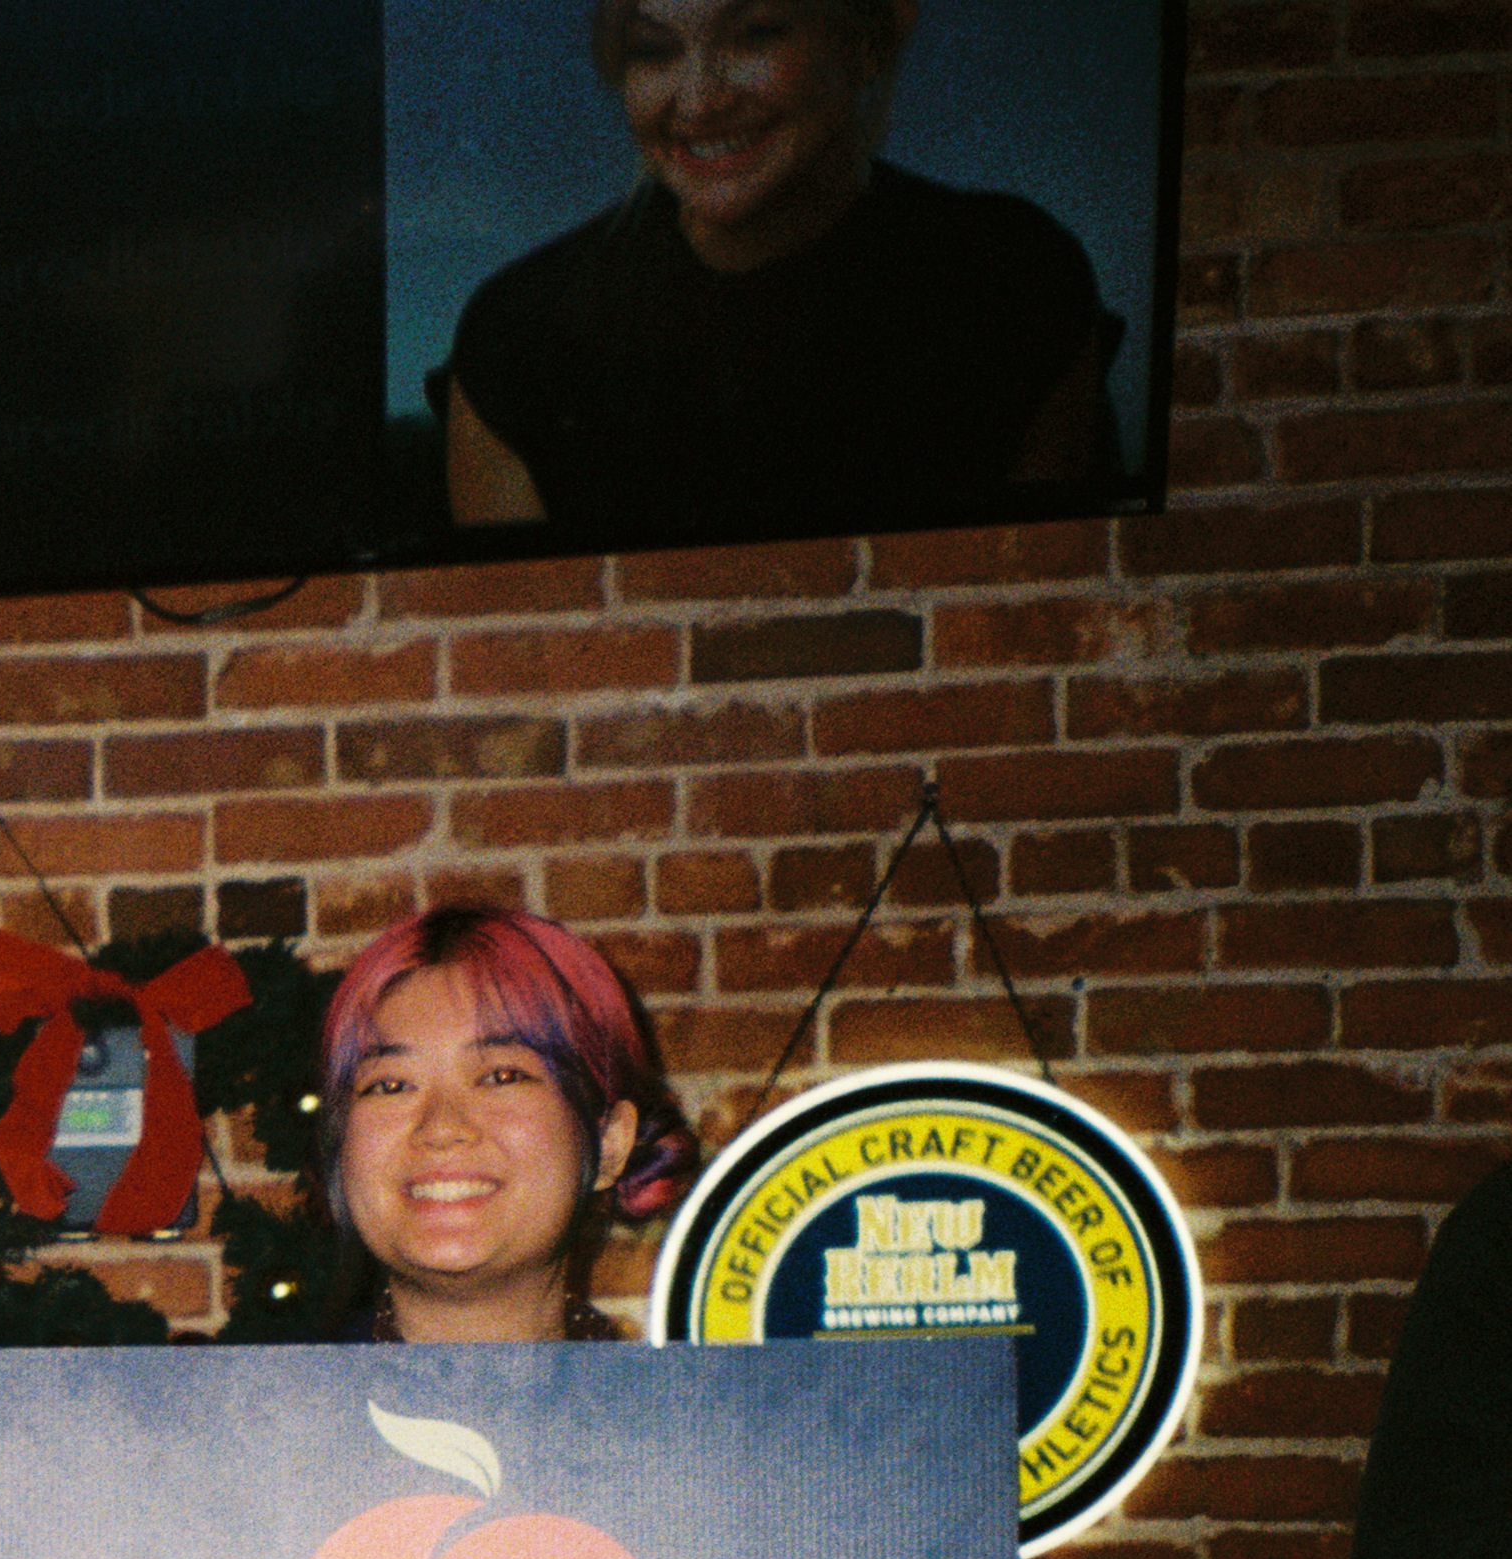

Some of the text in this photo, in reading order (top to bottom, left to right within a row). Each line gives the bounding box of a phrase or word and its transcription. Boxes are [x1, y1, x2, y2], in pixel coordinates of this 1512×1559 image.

[720, 1126, 1137, 1483] OFFICIAL CRAFT BEER OF HLETICS
